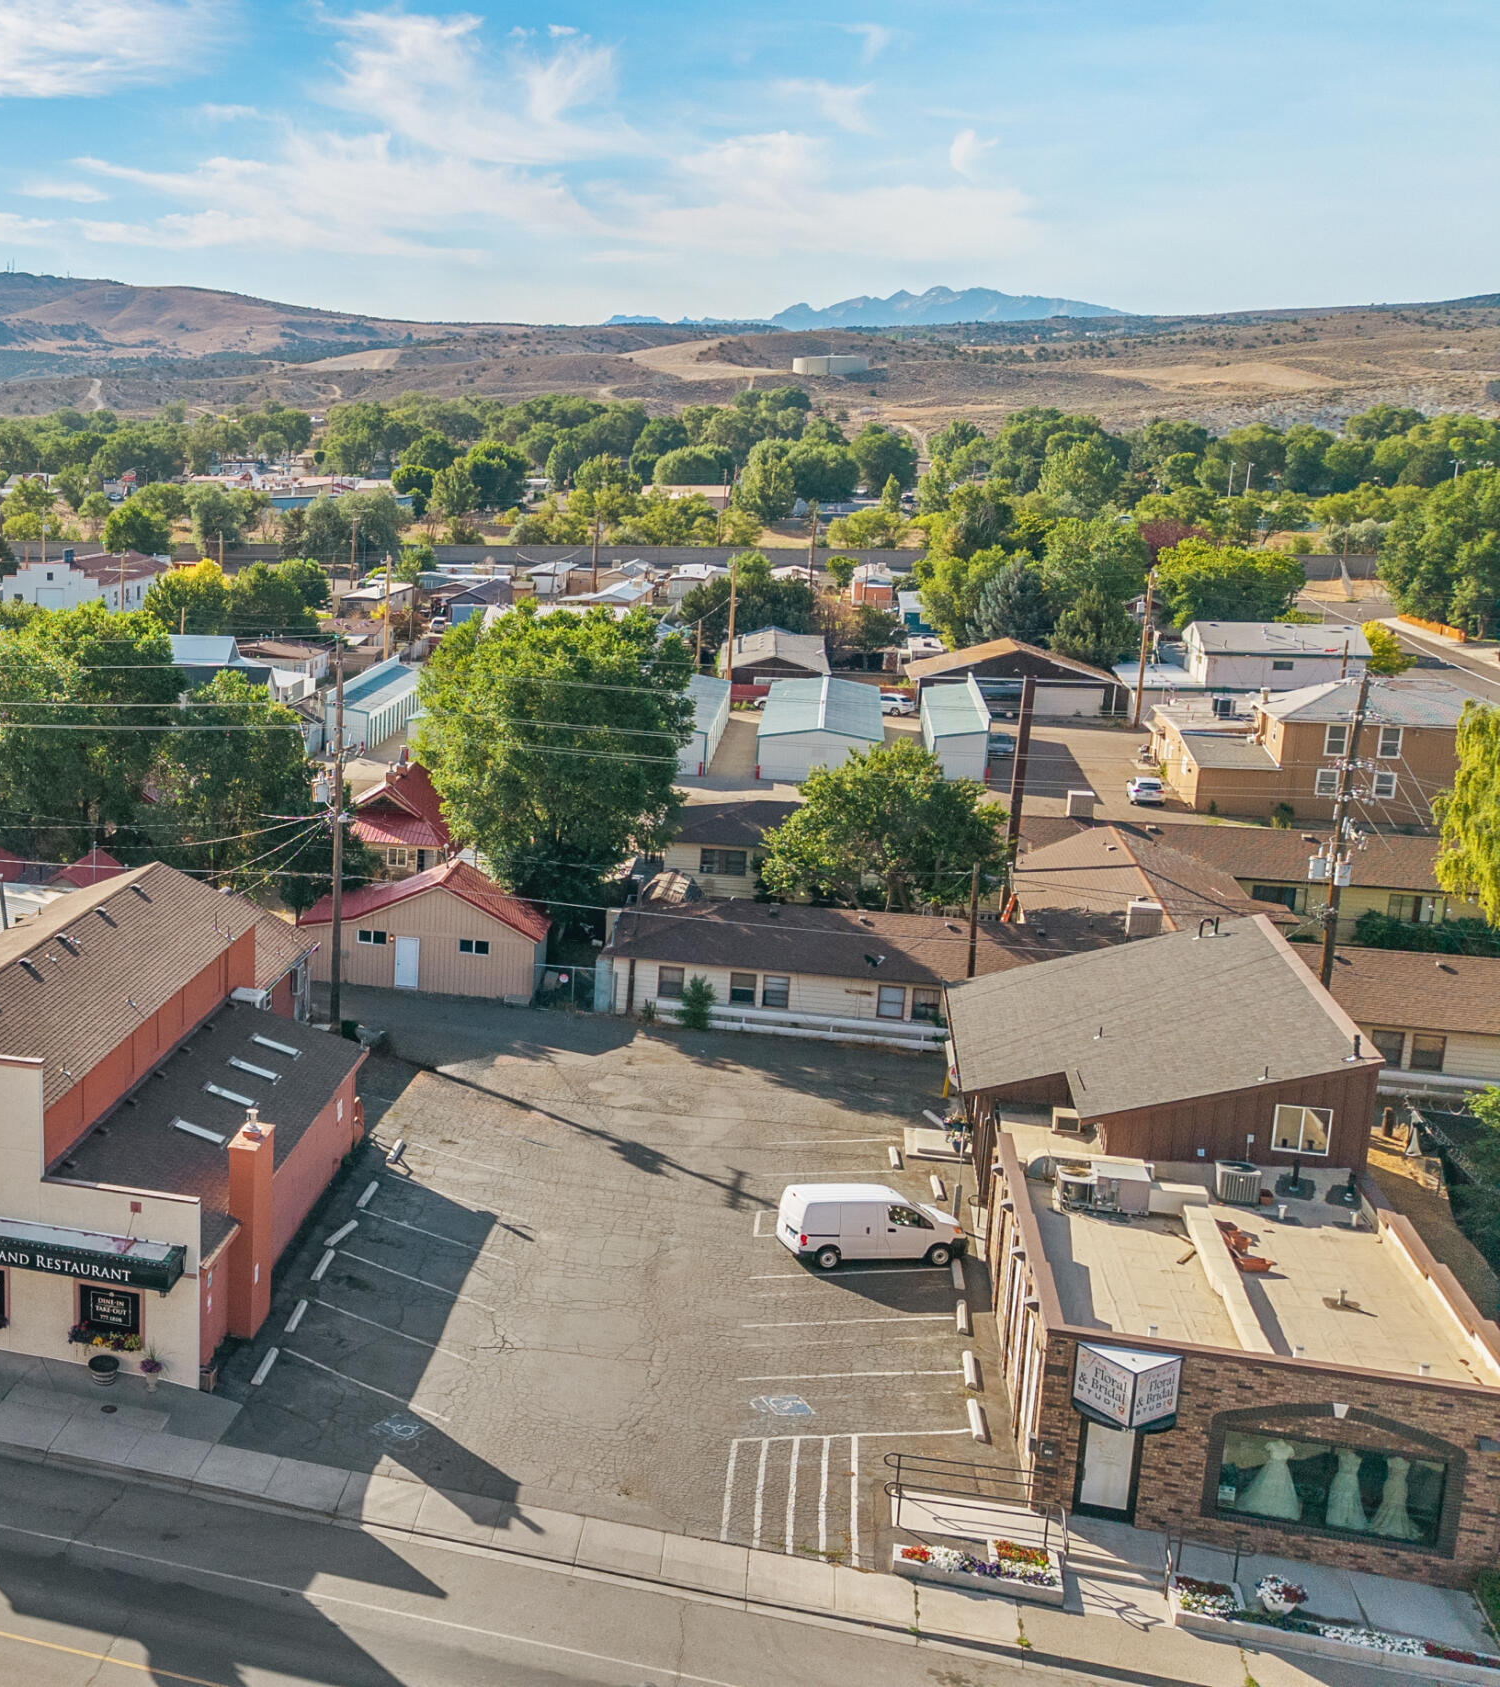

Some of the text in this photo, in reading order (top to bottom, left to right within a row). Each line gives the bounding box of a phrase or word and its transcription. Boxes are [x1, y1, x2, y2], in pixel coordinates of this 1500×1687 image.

[36, 1254, 132, 1282] RESTAURANT
[1091, 1378, 1126, 1406] Bridal
[1094, 1366, 1128, 1393] Floral
[1149, 1373, 1176, 1393] Floral
[1146, 1385, 1174, 1405] Bridal
